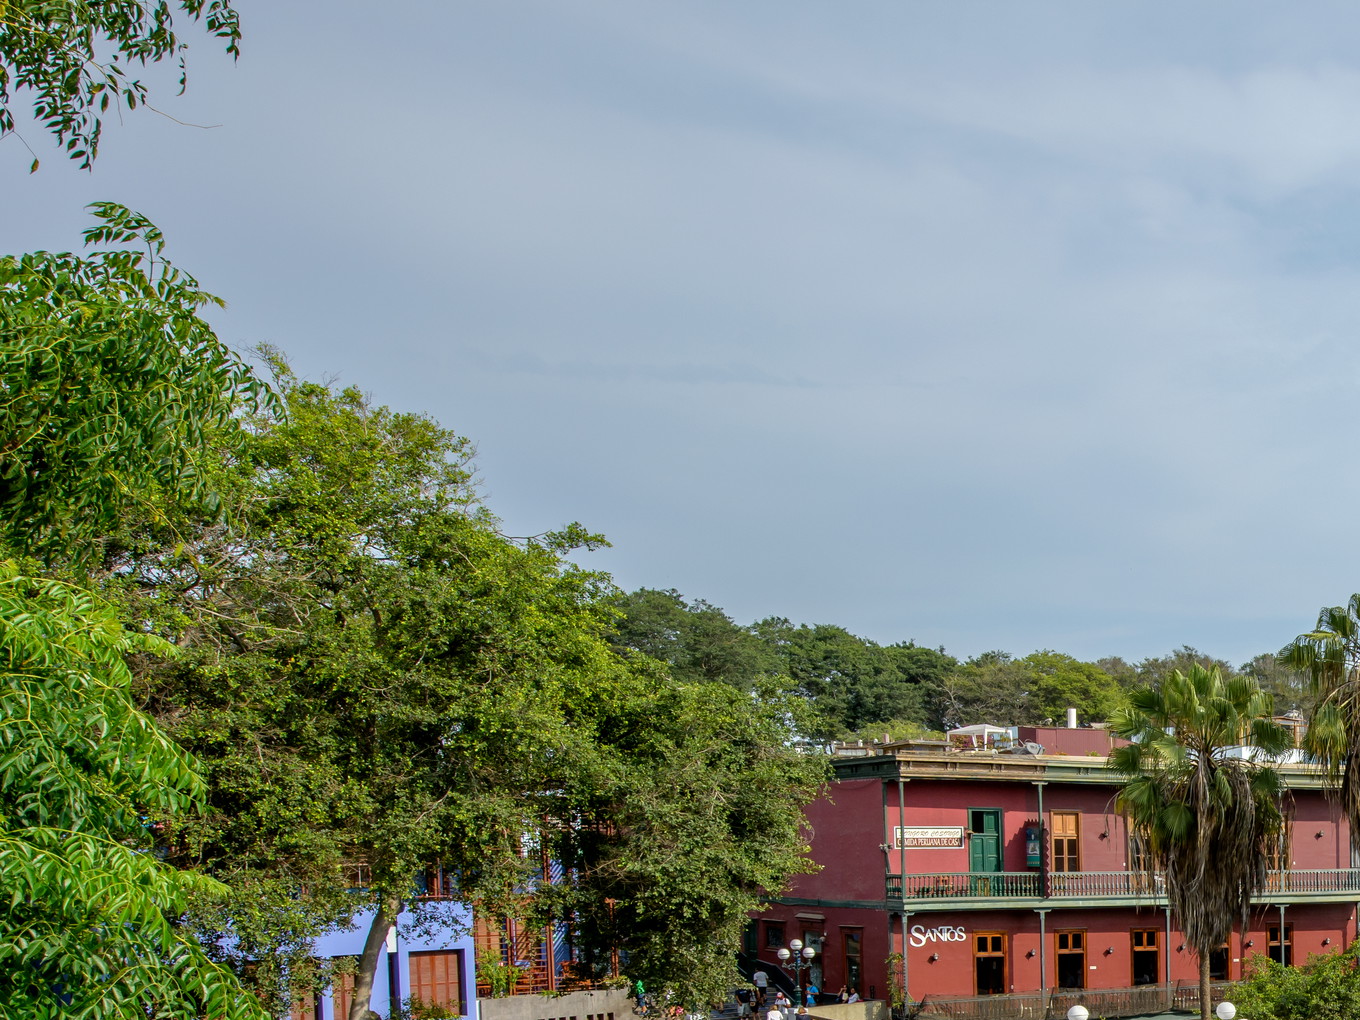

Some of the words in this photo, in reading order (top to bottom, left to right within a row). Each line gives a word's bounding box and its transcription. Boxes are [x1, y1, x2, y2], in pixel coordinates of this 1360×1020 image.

[897, 838, 917, 846] CMIDA
[918, 838, 940, 846] PERUANA
[941, 838, 948, 846] DE
[948, 838, 961, 846] CASA
[910, 925, 967, 947] SANTOS
